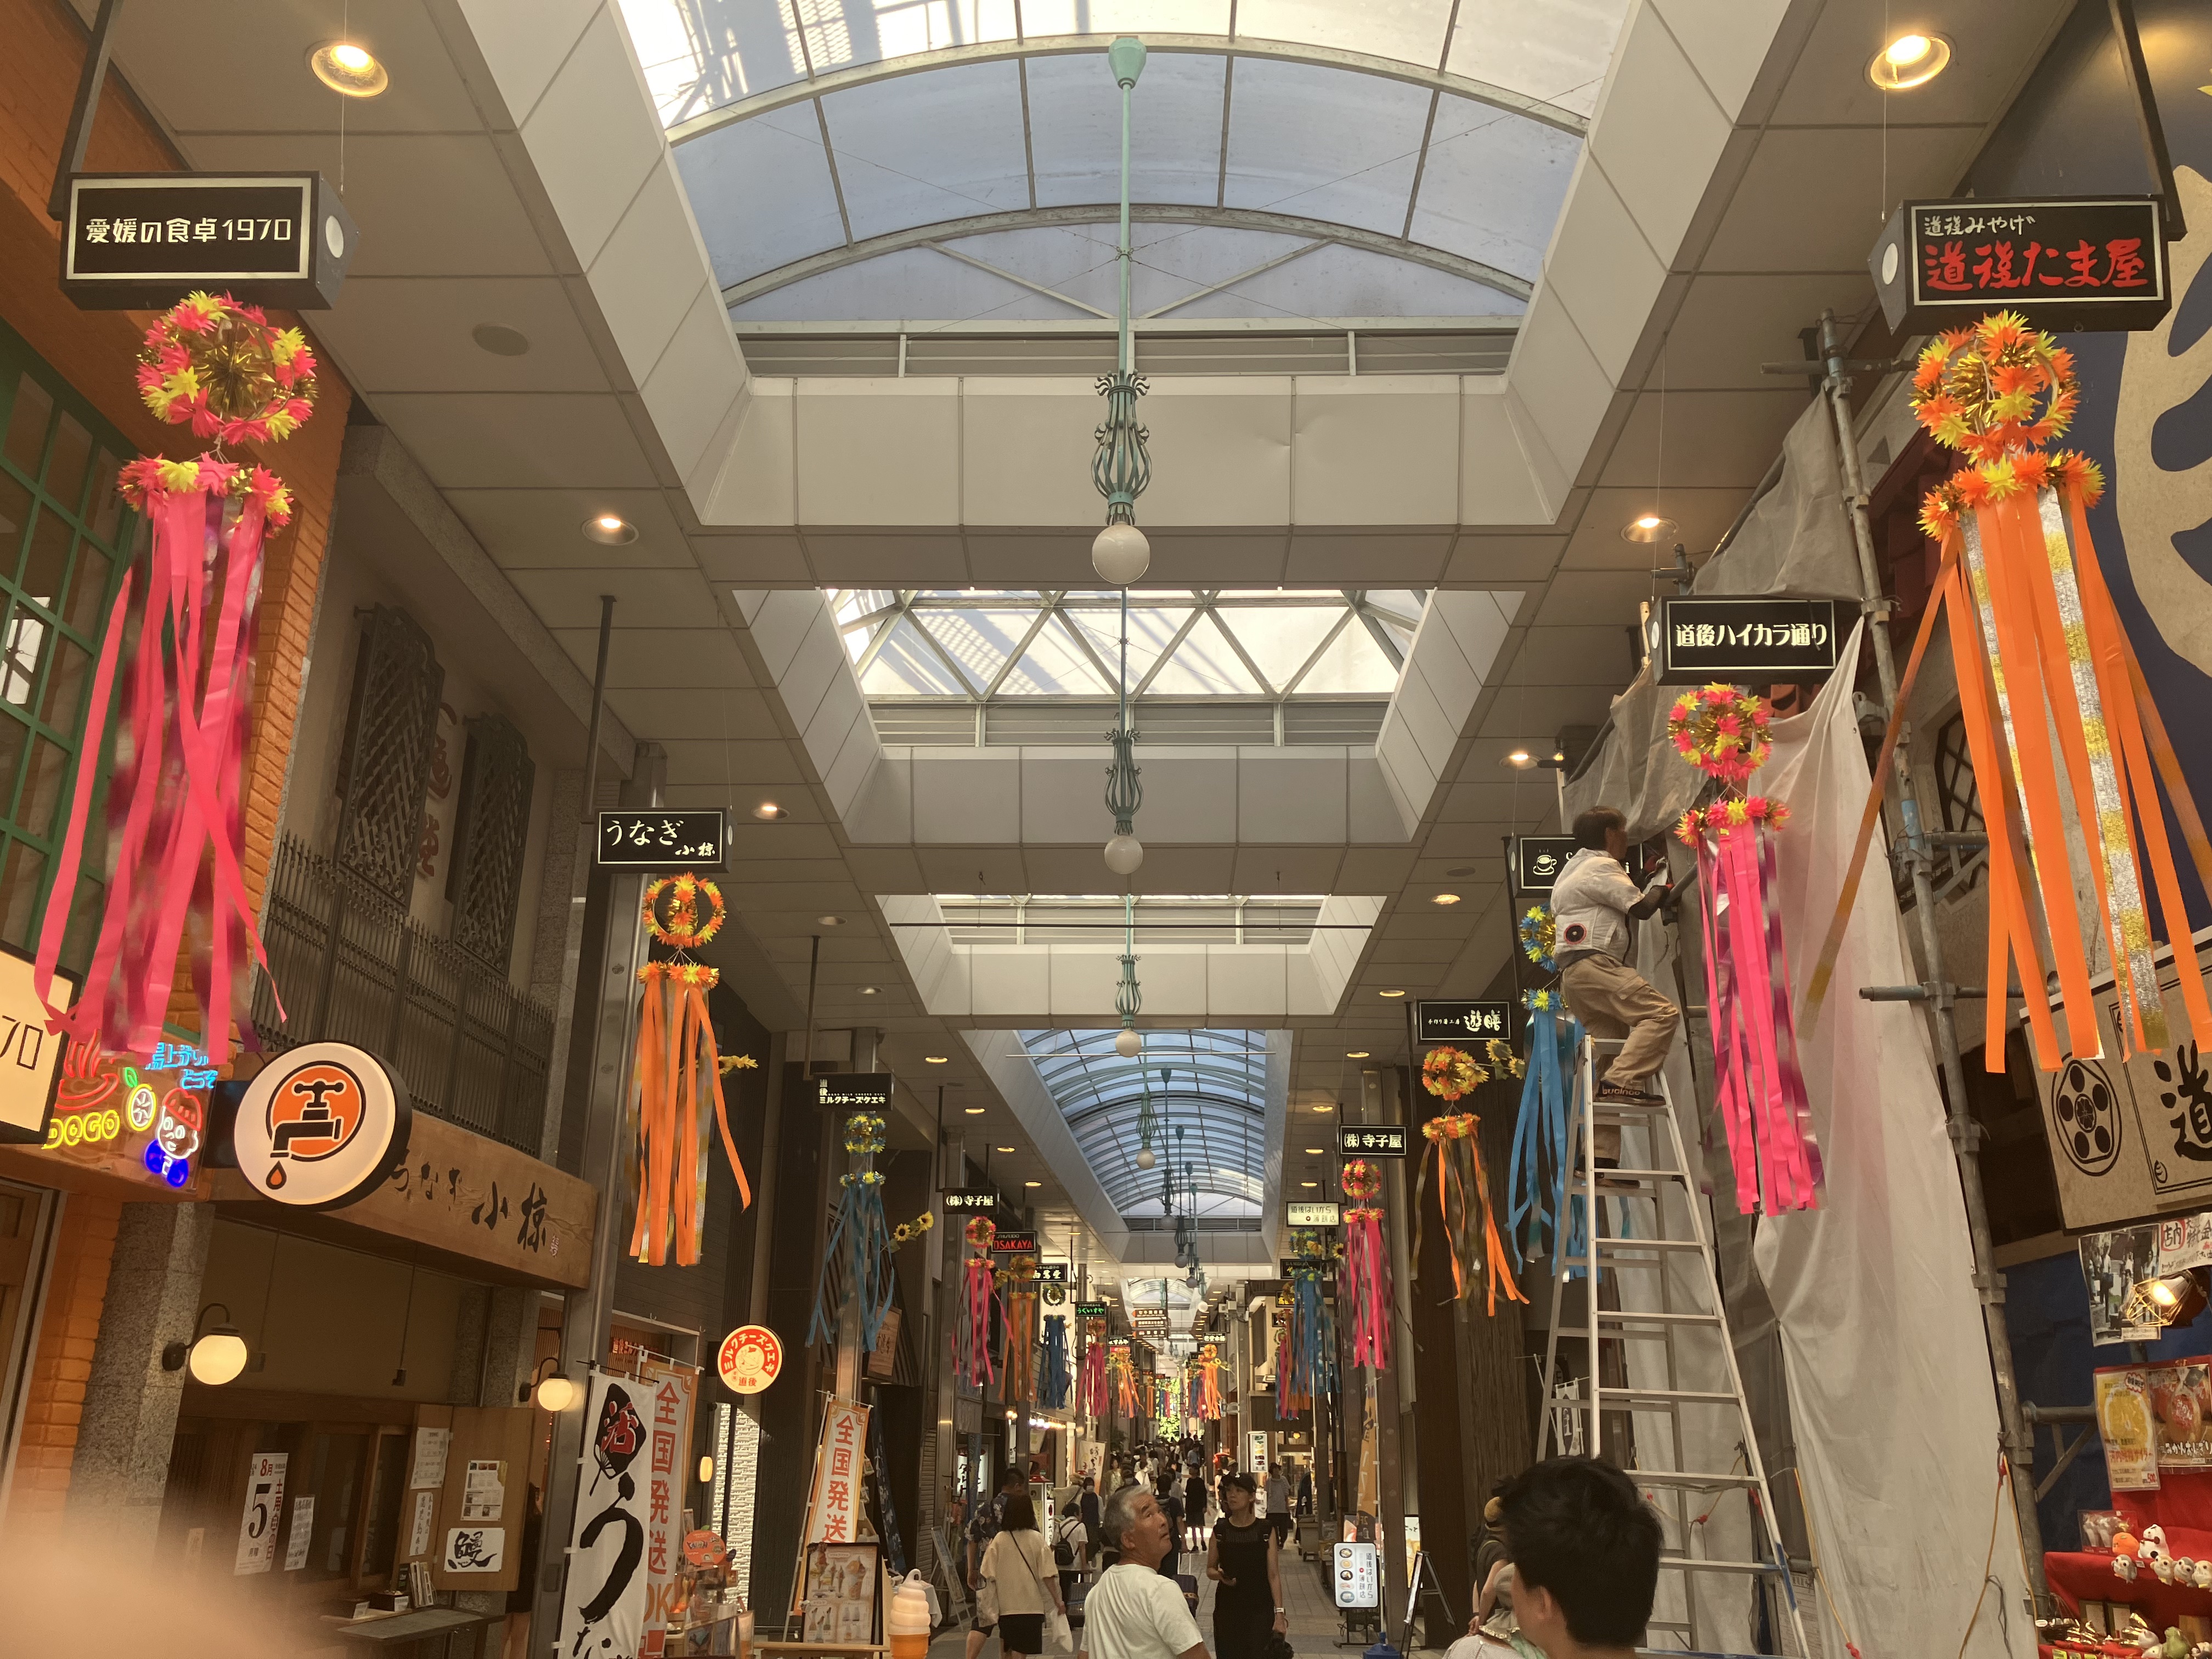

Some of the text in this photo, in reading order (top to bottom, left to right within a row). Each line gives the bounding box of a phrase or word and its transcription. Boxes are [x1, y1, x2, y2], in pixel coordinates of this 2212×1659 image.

[86, 218, 291, 243] 愛媛の食卓1970
[1923, 215, 2036, 236] 道後みやげ
[1925, 238, 2148, 291] 道後たま屋
[1675, 623, 1827, 647] 道後ハイカラ通り
[607, 820, 715, 856] うなぎ 小椋
[994, 1240, 1033, 1250] OSAKAYA
[724, 1333, 775, 1373] ミルクチーズケエキ
[738, 1377, 757, 1386] 道後
[260, 1458, 273, 1476] 8月
[648, 1381, 681, 1575] 全国発送
[822, 1415, 854, 1543] 全国発送
[249, 1483, 272, 1539] 5
